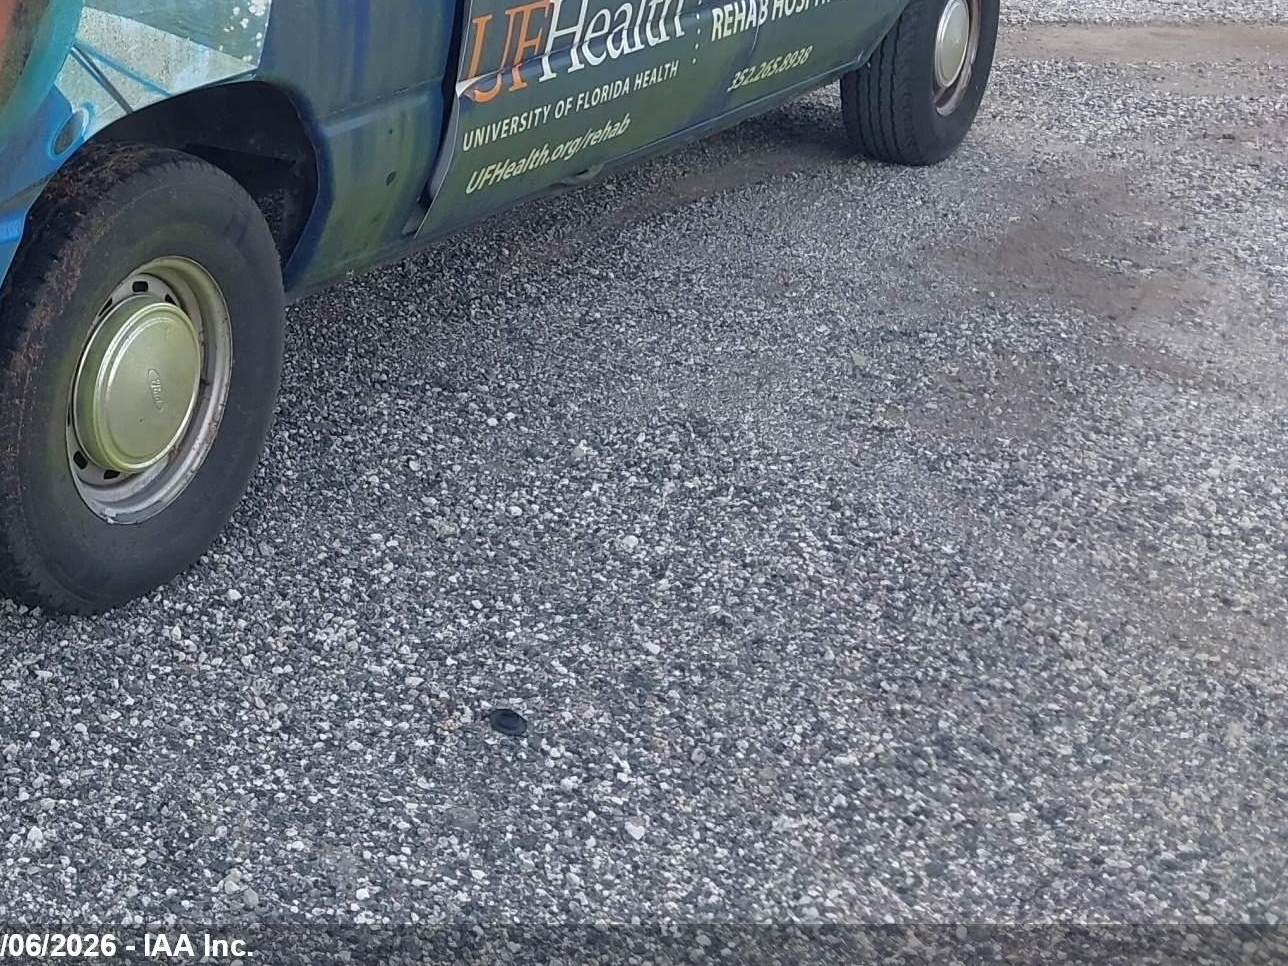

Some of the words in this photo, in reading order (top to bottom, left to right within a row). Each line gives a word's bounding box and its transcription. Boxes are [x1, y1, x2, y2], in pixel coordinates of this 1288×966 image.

[463, 103, 552, 152] UNIVERSITY
[554, 97, 573, 119] OF
[575, 77, 630, 112] FLORIDA
[633, 59, 680, 91] HEALTH
[726, 45, 814, 93] 352.265.8938
[465, 112, 632, 195] UFHealth.org/rehab
